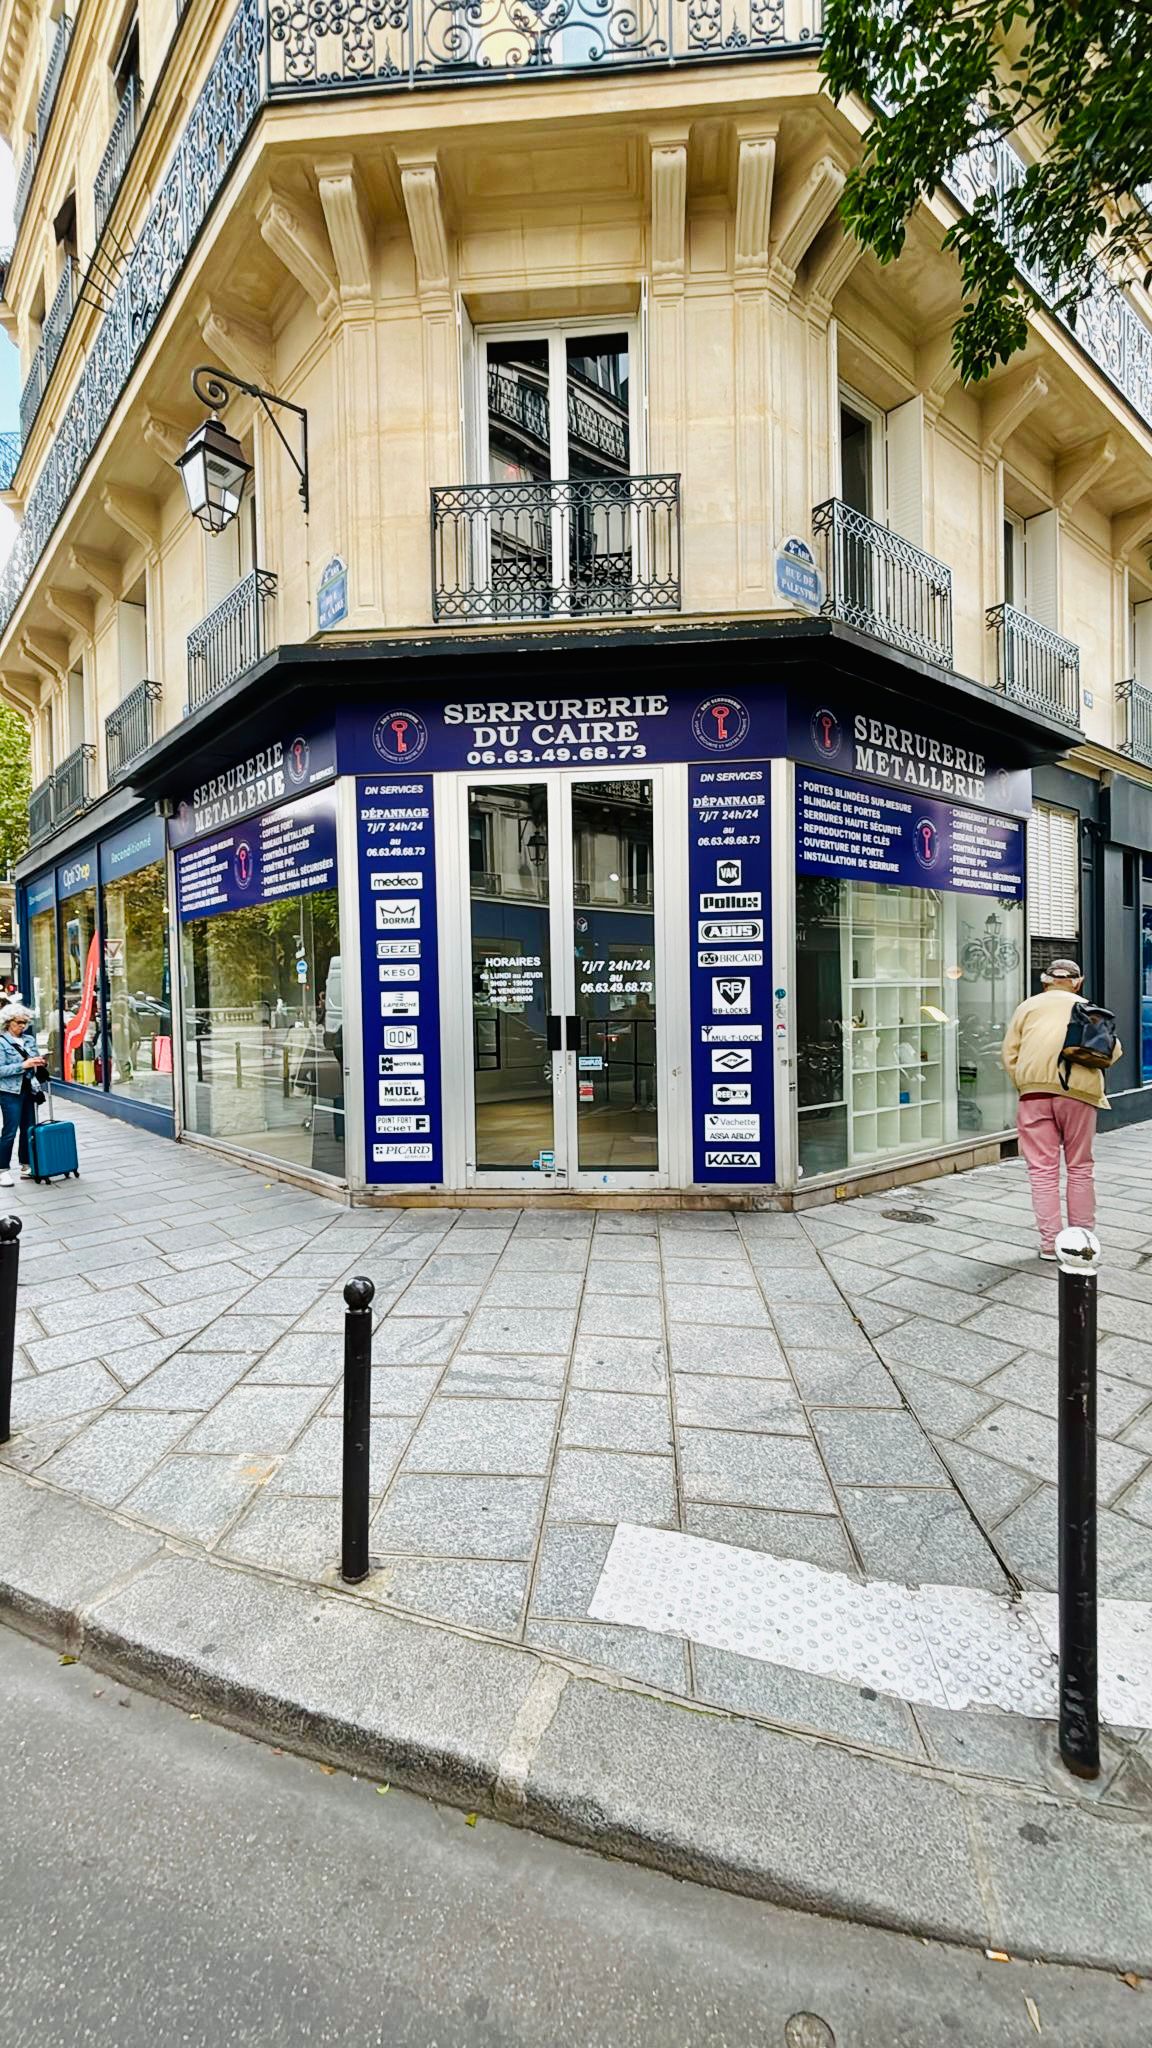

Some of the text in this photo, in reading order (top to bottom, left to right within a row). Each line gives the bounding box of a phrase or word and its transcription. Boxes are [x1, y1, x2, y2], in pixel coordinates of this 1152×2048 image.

[785, 565, 801, 581] RUE
[444, 695, 669, 724] SERRURERIE
[473, 720, 639, 747] DU CAIRE
[854, 715, 986, 777] SERRURERIE
[467, 745, 647, 765] 06.63.49.68.73
[193, 741, 284, 809] SERRURERIE
[700, 771, 763, 783] DN SERVICES
[855, 745, 986, 801] METALLERIE
[365, 784, 424, 795] DN SERVICES
[195, 770, 286, 833] METALLERIE
[692, 795, 766, 808] DÉPANNAGE
[803, 781, 912, 814] PORTES BLINDÉES SUR-MESURE
[361, 807, 429, 819] DÉPANNAGE
[803, 795, 881, 819] BLINDAGE DE PORTES
[698, 809, 759, 823] 7j/7 24h/24
[367, 821, 424, 834] 7j/7 24h/24
[803, 809, 902, 836] SERRURES HAUTE SÉCURITÉ
[723, 826, 735, 834] au
[803, 823, 862, 841] REPRODUCTION
[862, 833, 872, 843] DE
[389, 838, 401, 846] au
[697, 836, 761, 847] 06.63.49.68.73
[803, 837, 884, 858] OUVERTURE DE PORTE
[366, 847, 426, 857] 06.63.49.68.73
[803, 851, 900, 873] INSTALLATION DE SERRURE
[720, 867, 738, 879] VAK
[373, 875, 419, 887] medeco
[703, 896, 759, 909] Pollux
[382, 917, 415, 925] DORMA
[709, 926, 753, 938] ABUS
[380, 944, 416, 954] GEZE
[485, 956, 541, 967] HORAIRES
[720, 953, 762, 963] BRICARD
[383, 968, 415, 977] KESO
[582, 960, 651, 974] 7j/7 24h/24
[522, 971, 543, 979] JEUDI
[609, 974, 623, 982] au
[580, 982, 653, 993] 06.63.49.68.73
[719, 982, 743, 998] RB
[389, 1030, 412, 1044] DOM
[384, 1086, 419, 1096] MUEL
[720, 1118, 756, 1126] Vachette
[731, 1132, 756, 1140] ABLOY
[386, 1145, 431, 1155] PICARD
[708, 1154, 757, 1166] KABA
